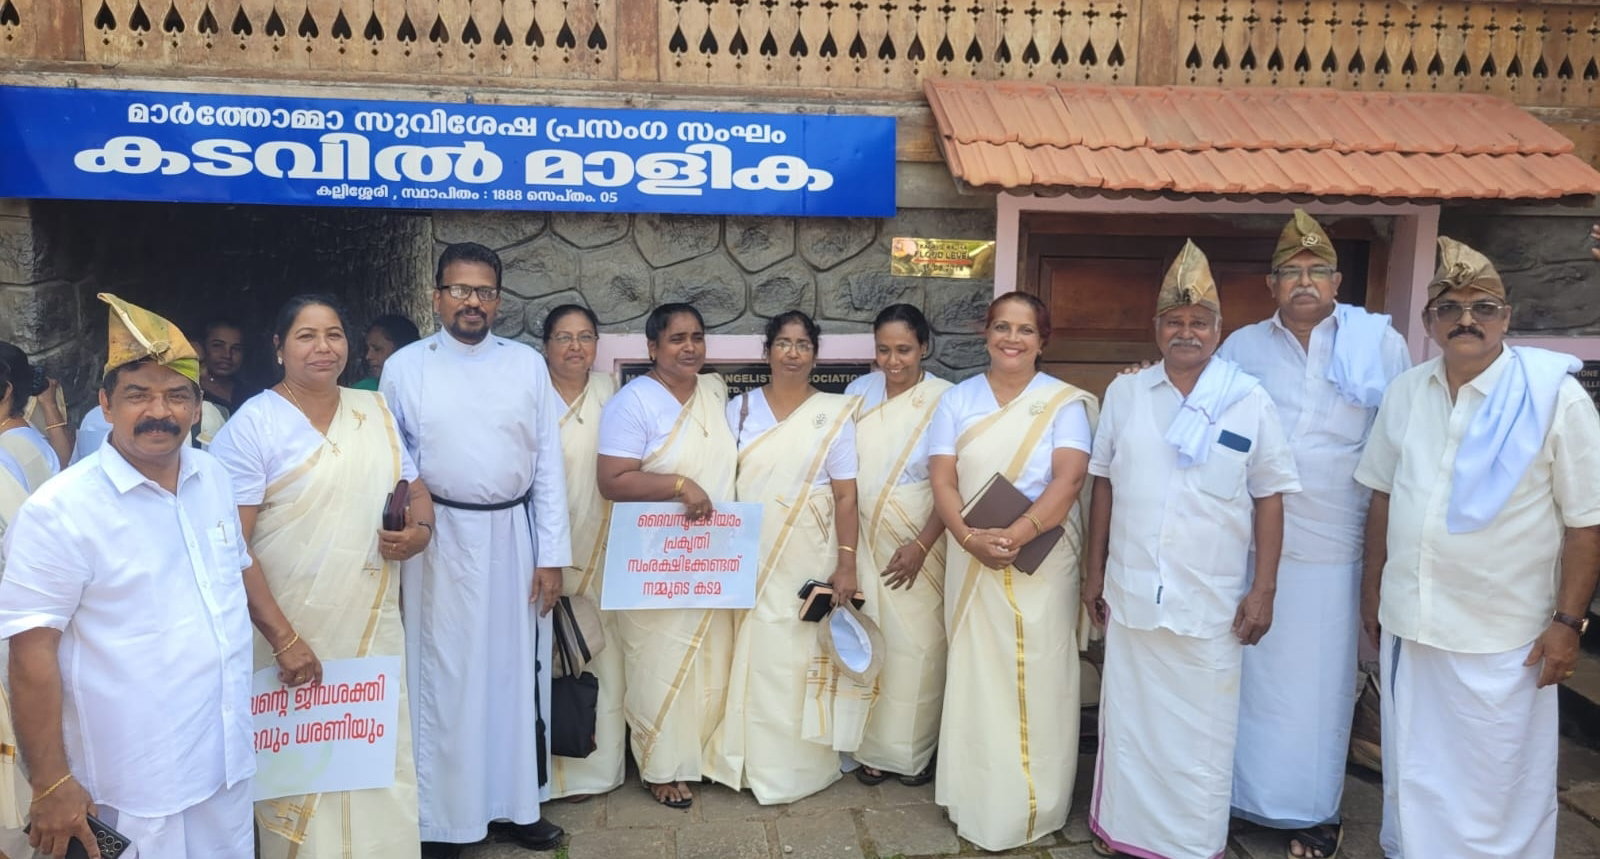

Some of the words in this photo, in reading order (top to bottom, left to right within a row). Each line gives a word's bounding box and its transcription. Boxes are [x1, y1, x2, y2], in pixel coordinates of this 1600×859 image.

[128, 102, 344, 130] മാർത്തോമ്മാ
[355, 109, 537, 138] സുവിശേഷ
[545, 118, 669, 142] പ്രസംഗ
[677, 121, 786, 143] സംഘം
[74, 133, 503, 183] കടവിൽ
[525, 143, 833, 195] മാളിക
[401, 186, 480, 200] സ്ഥാപിതം
[491, 189, 523, 201] 1888
[599, 191, 619, 203] 05
[693, 581, 722, 595] കടമ
[296, 712, 384, 744] ധരണിയും
